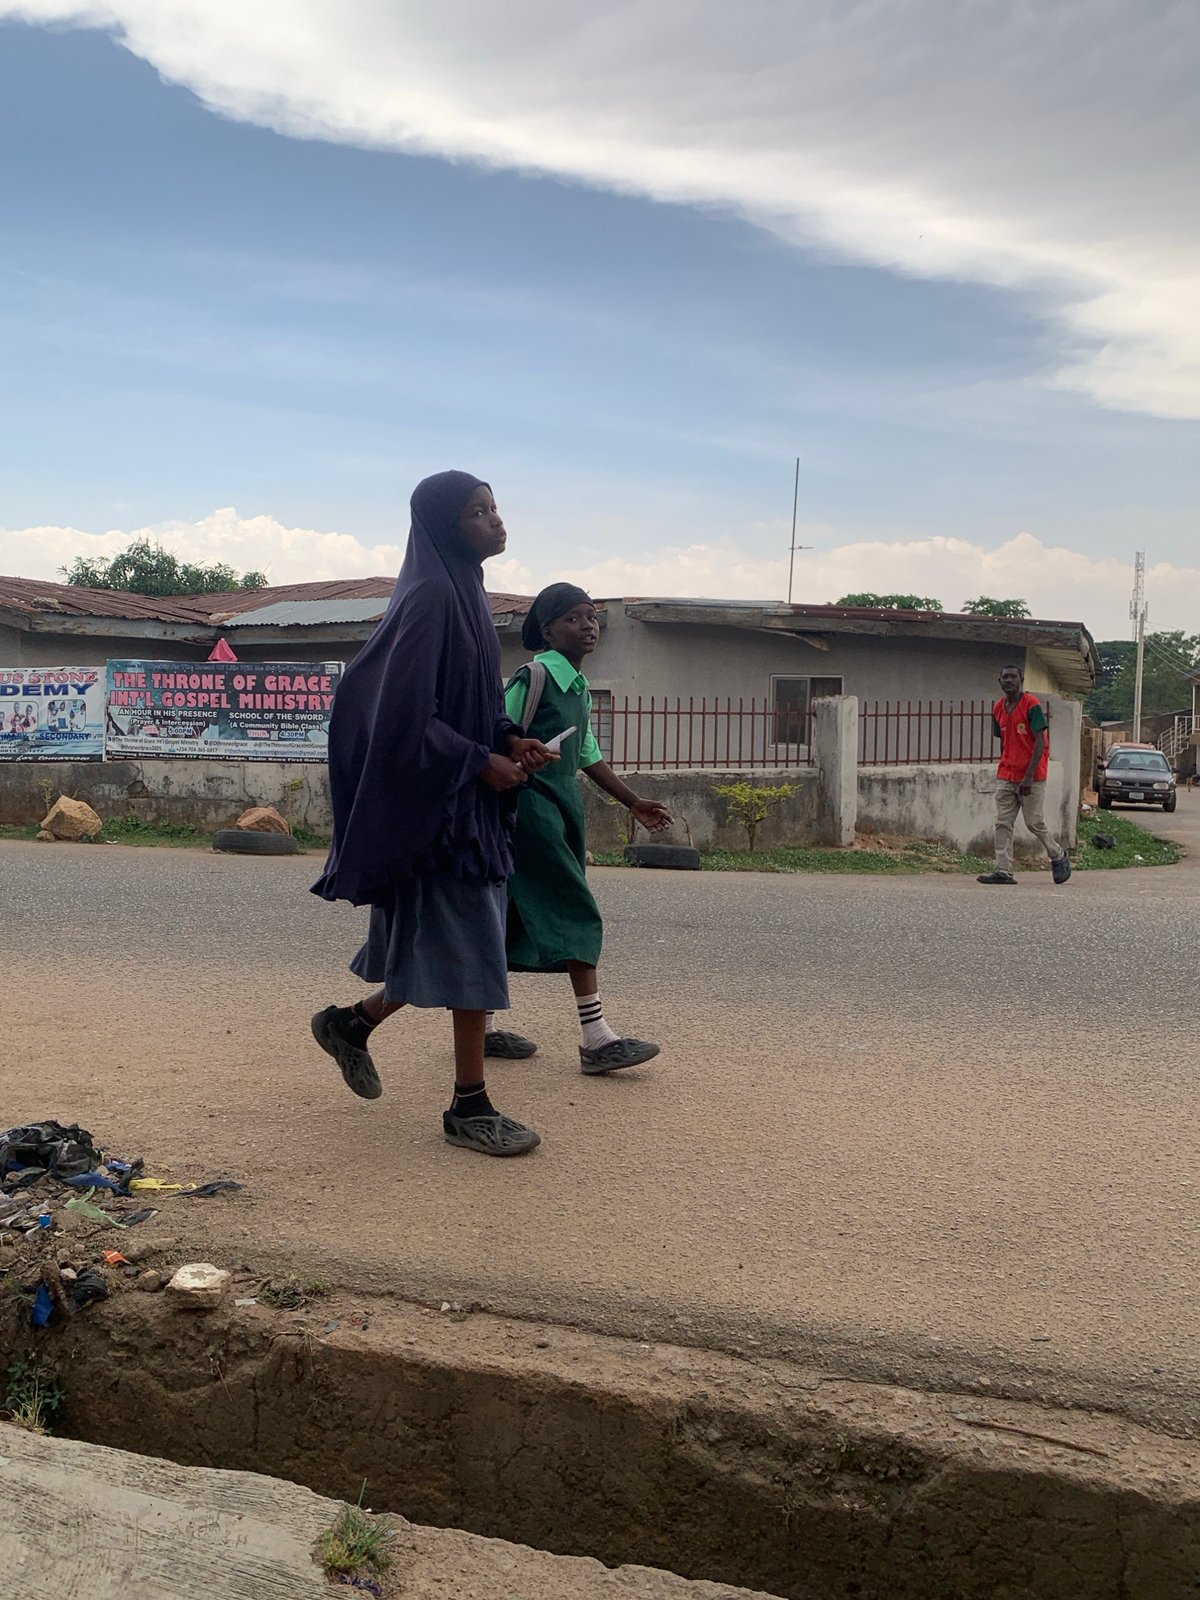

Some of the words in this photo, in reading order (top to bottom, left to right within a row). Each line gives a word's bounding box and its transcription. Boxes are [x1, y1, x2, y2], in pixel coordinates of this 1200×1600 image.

[28, 671, 98, 684] STONE
[113, 672, 147, 688] THE
[151, 673, 225, 690] THRONE
[233, 674, 257, 691] OF
[264, 675, 332, 692] GRACE
[0, 683, 94, 696] DEMY
[110, 690, 155, 707] INT'L
[161, 691, 231, 708] GOSPEL
[238, 693, 335, 710] MINISTRY
[178, 710, 218, 718] PRESENCE
[228, 712, 262, 720] SCHOOL
[294, 713, 324, 721] SWORD
[130, 718, 154, 726] (Prayer
[161, 719, 206, 727] Intercession)
[239, 722, 279, 730] Community
[300, 723, 323, 731] Class)
[40, 732, 91, 740] SECONDARY
